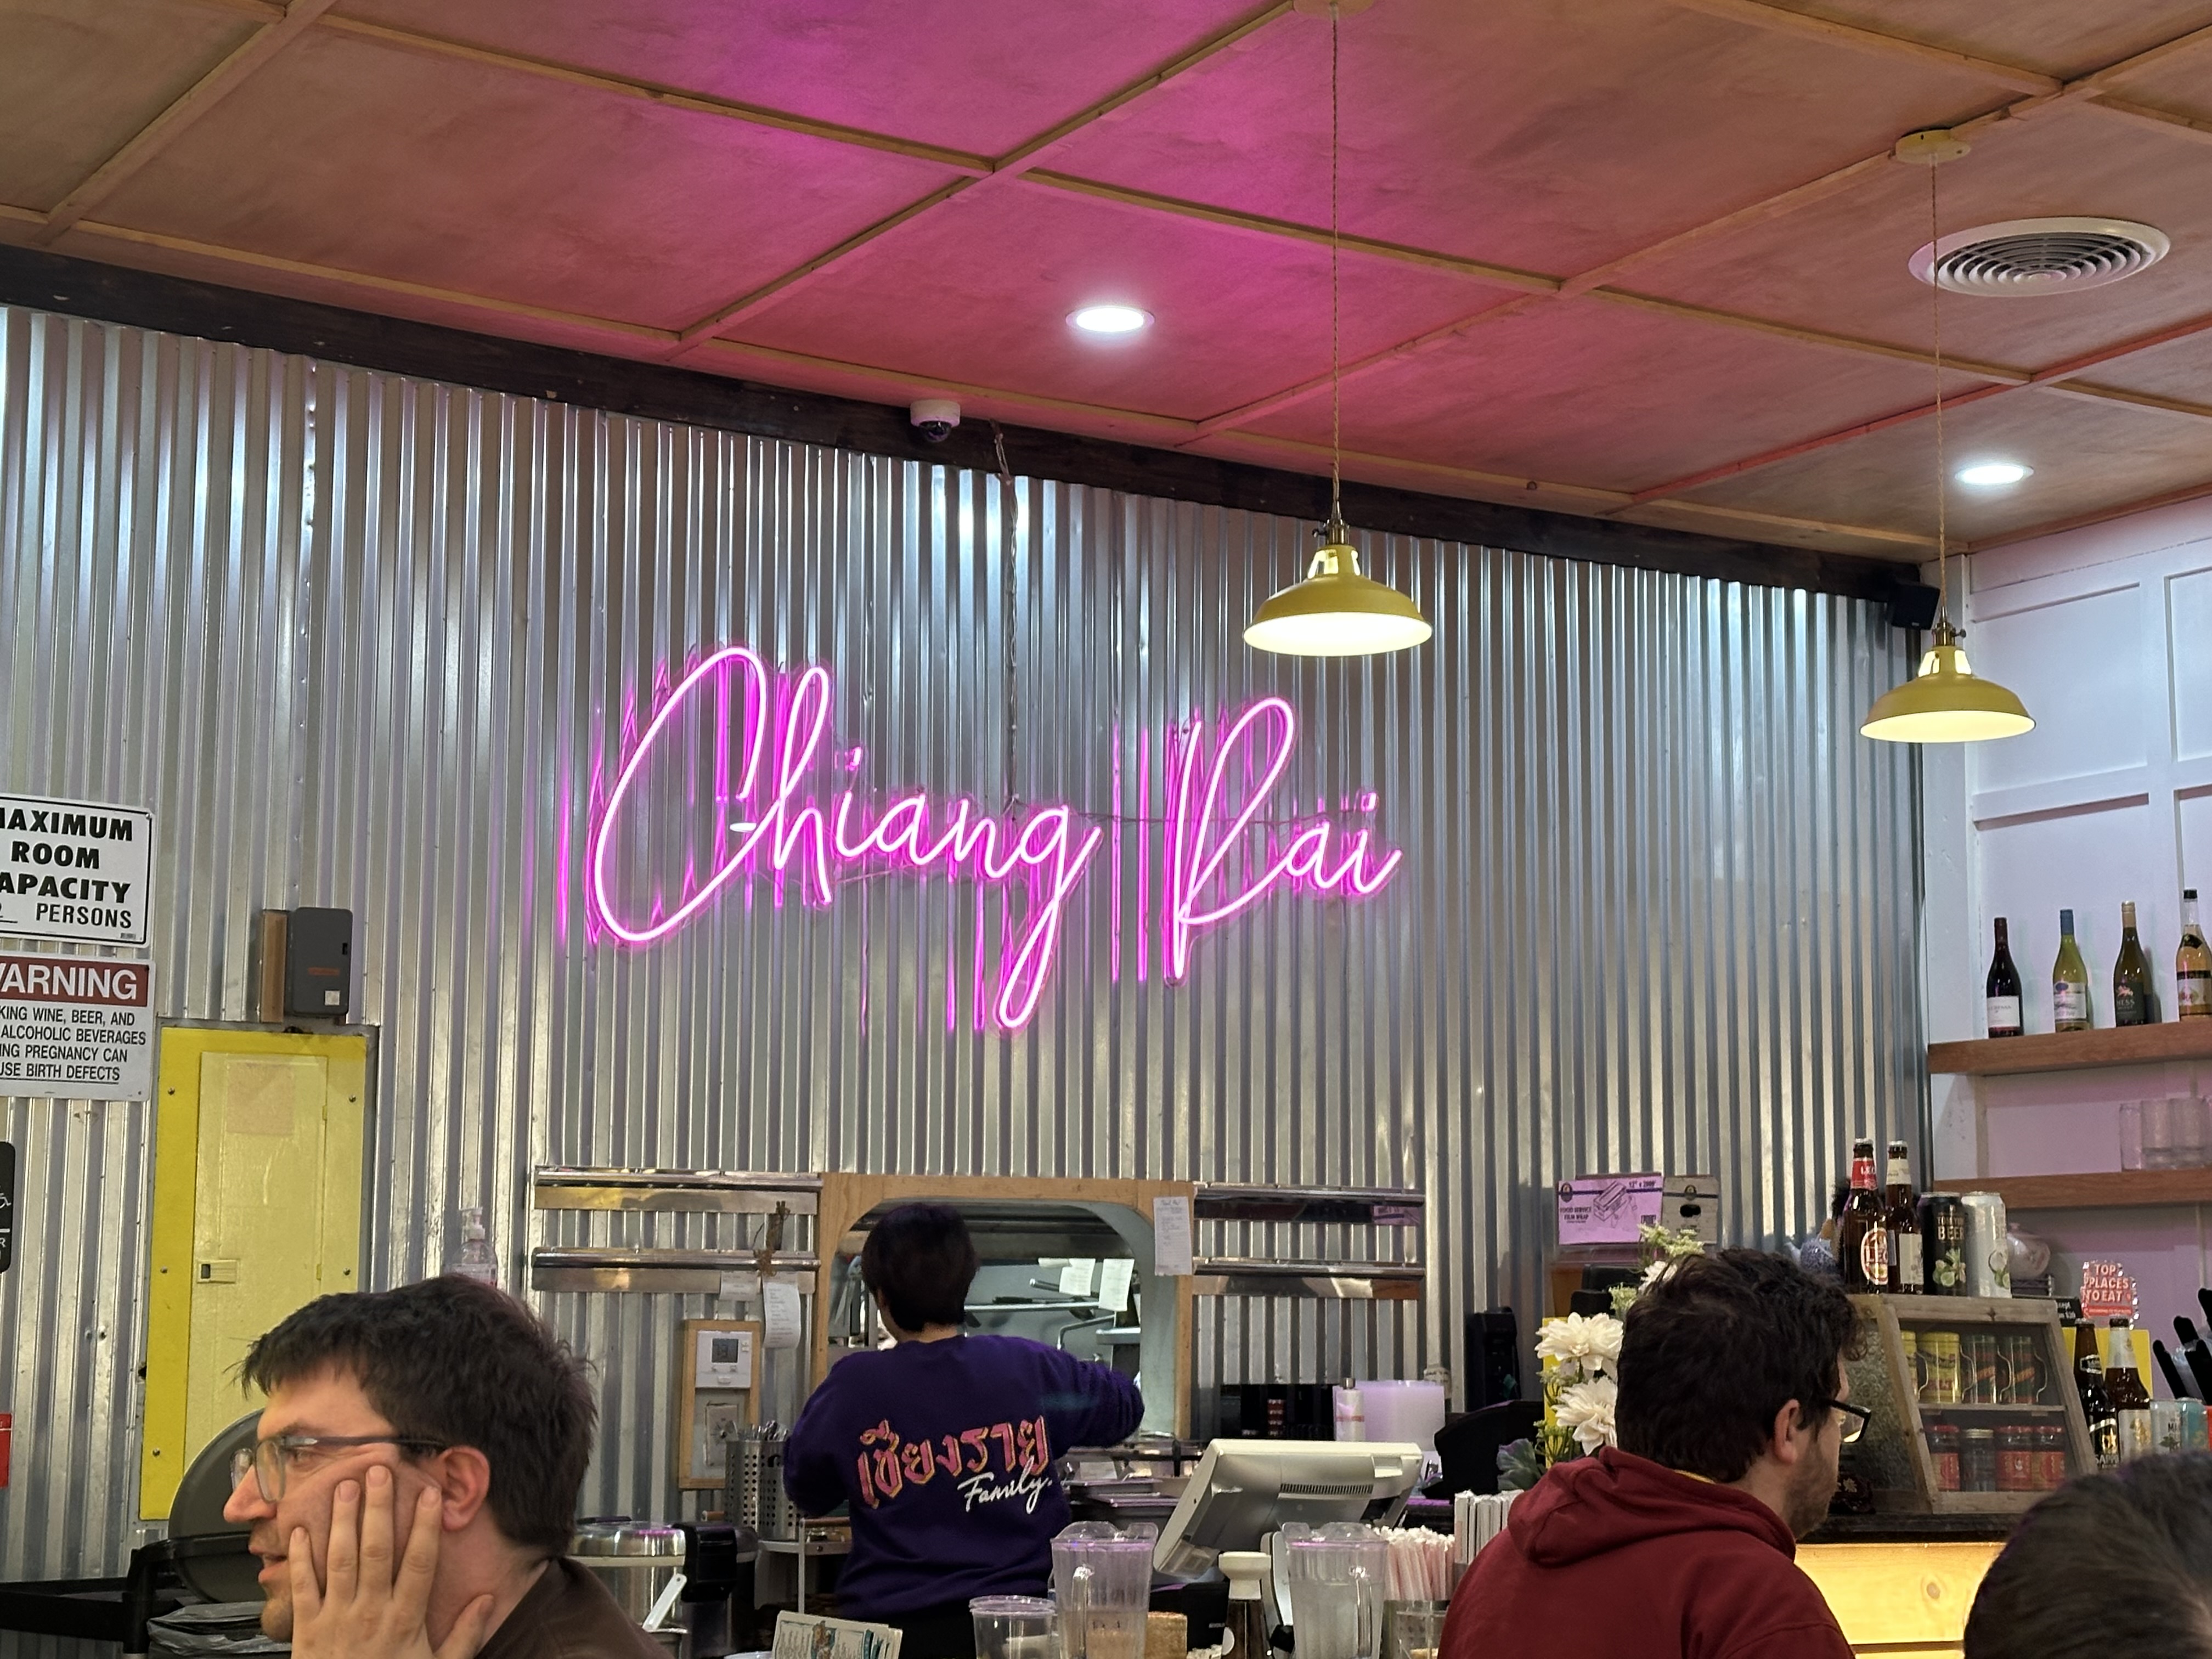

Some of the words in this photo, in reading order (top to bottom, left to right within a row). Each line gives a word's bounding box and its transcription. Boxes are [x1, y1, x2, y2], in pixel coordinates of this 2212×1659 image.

[0, 808, 132, 841] AXIMUM
[594, 646, 1101, 1030] Chiang
[1170, 696, 1403, 981] Rai
[11, 840, 99, 869] ROOM
[36, 902, 132, 929] PERSONS
[33, 1007, 66, 1025] WINE,
[71, 1009, 106, 1026] BEER,
[110, 1012, 135, 1026] AND
[1, 1025, 71, 1041] ALCOHOLIC
[76, 1028, 146, 1045] BEVERAGES
[25, 1045, 99, 1062] PREGNANCY
[103, 1048, 128, 1062] CAN
[26, 1063, 62, 1078] BIRTH
[66, 1065, 120, 1081] DEFECTS
[2094, 1263, 2117, 1276] TOP
[2088, 1277, 2129, 1289] PLACES
[2101, 1290, 2123, 1302] EAT
